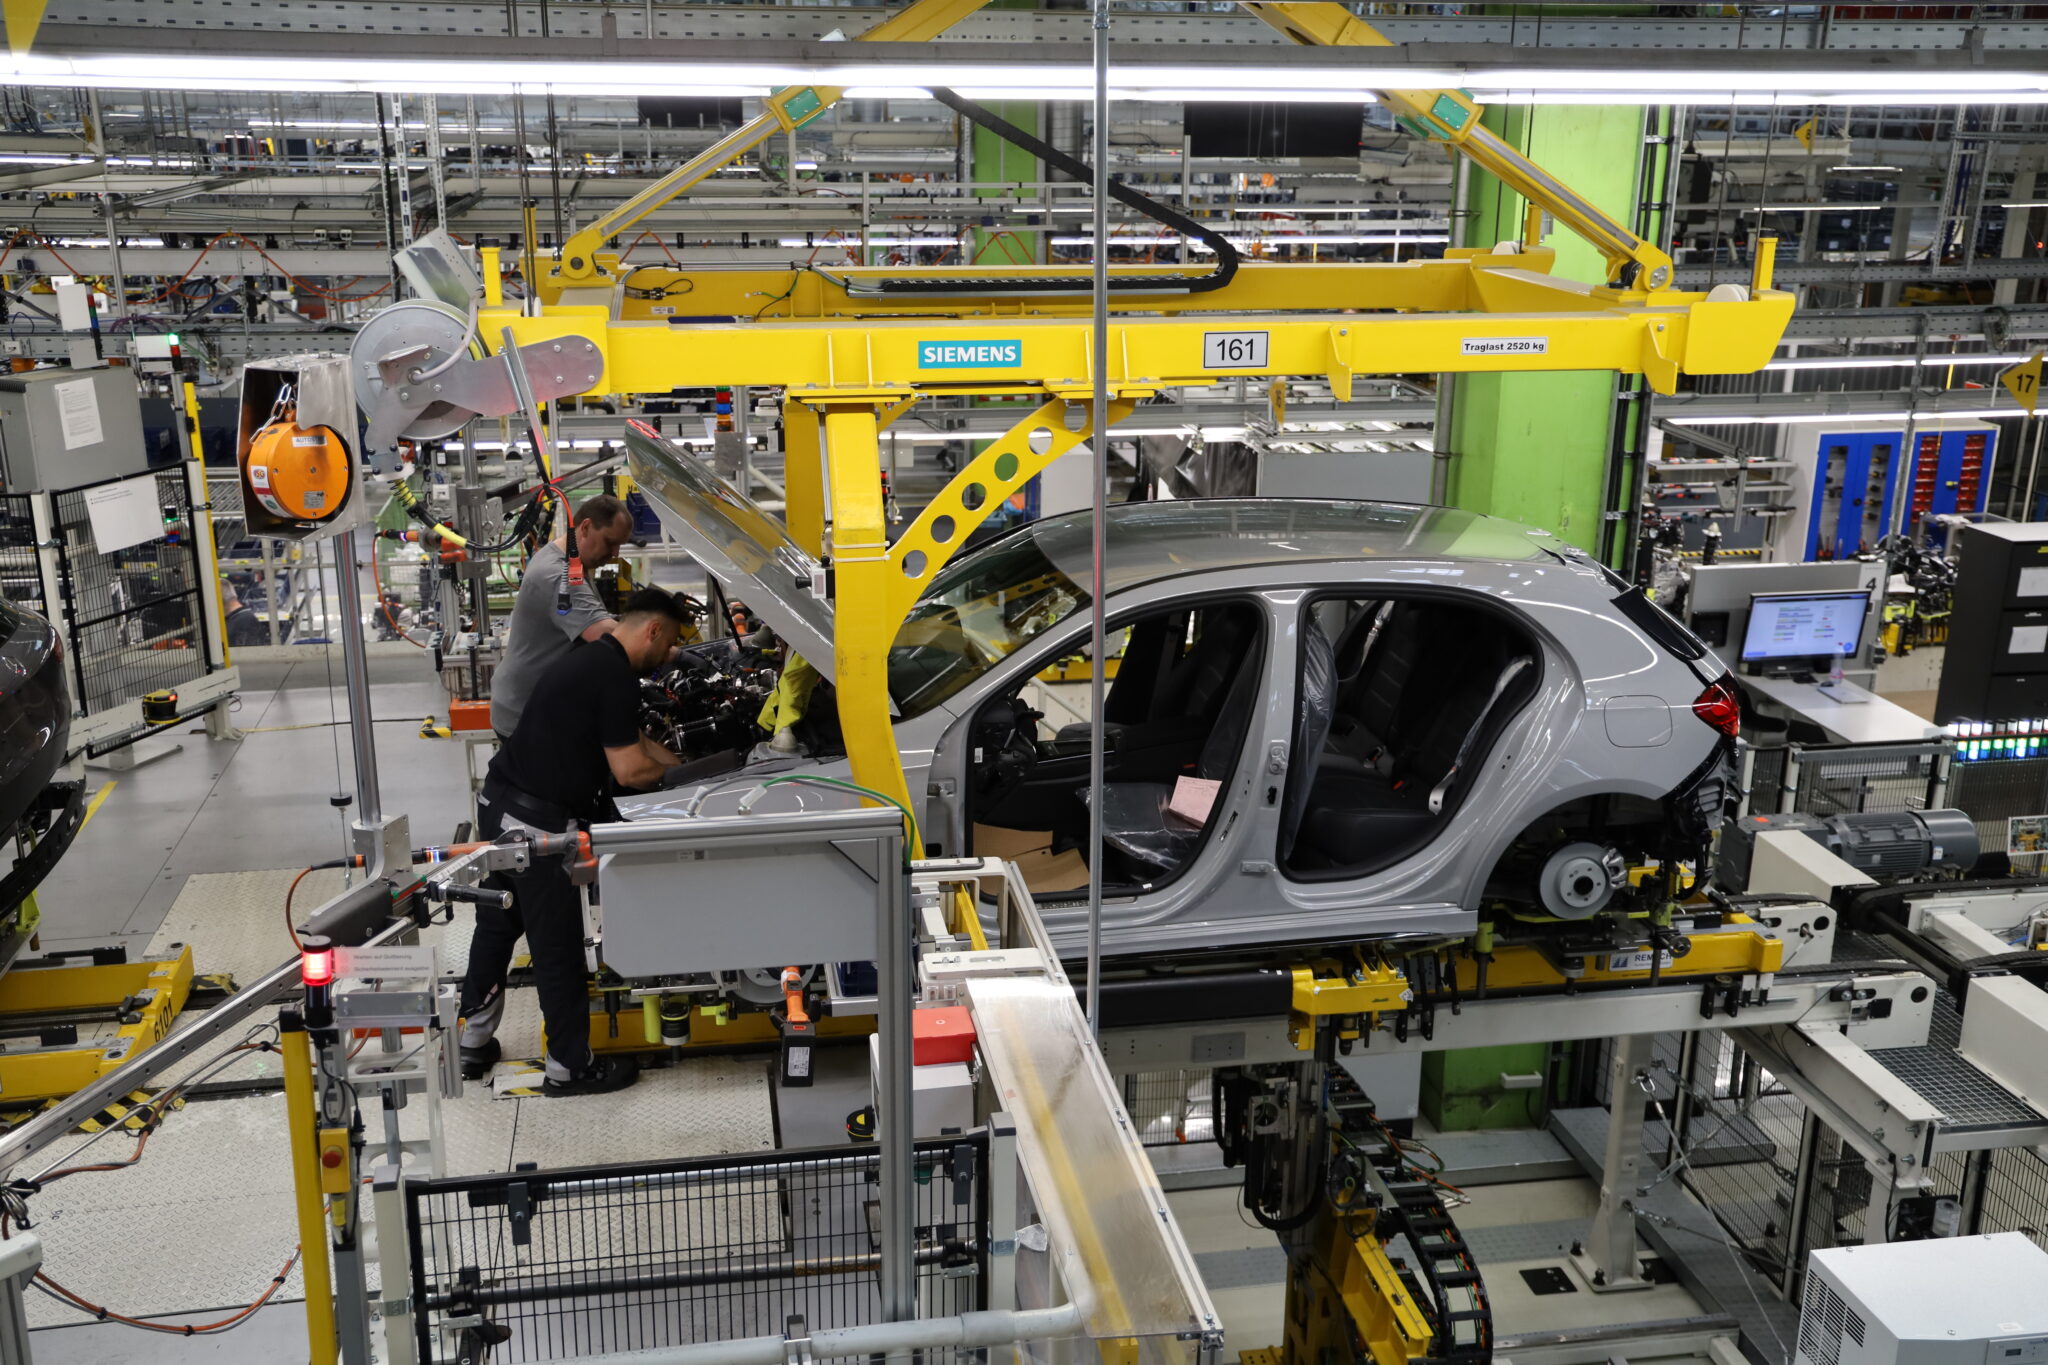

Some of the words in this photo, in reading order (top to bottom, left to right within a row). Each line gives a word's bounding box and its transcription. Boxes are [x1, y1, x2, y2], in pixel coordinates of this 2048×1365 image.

[924, 346, 1017, 363] SIEMENS
[1216, 338, 1254, 361] 161
[1464, 343, 1504, 353] Traglast
[1506, 342, 1531, 350] 2520
[1532, 342, 1545, 351] kg
[2016, 373, 2036, 393] 17
[1866, 577, 1876, 590] 4
[1634, 952, 1672, 961] REMCH
[154, 997, 173, 1043] 6101
